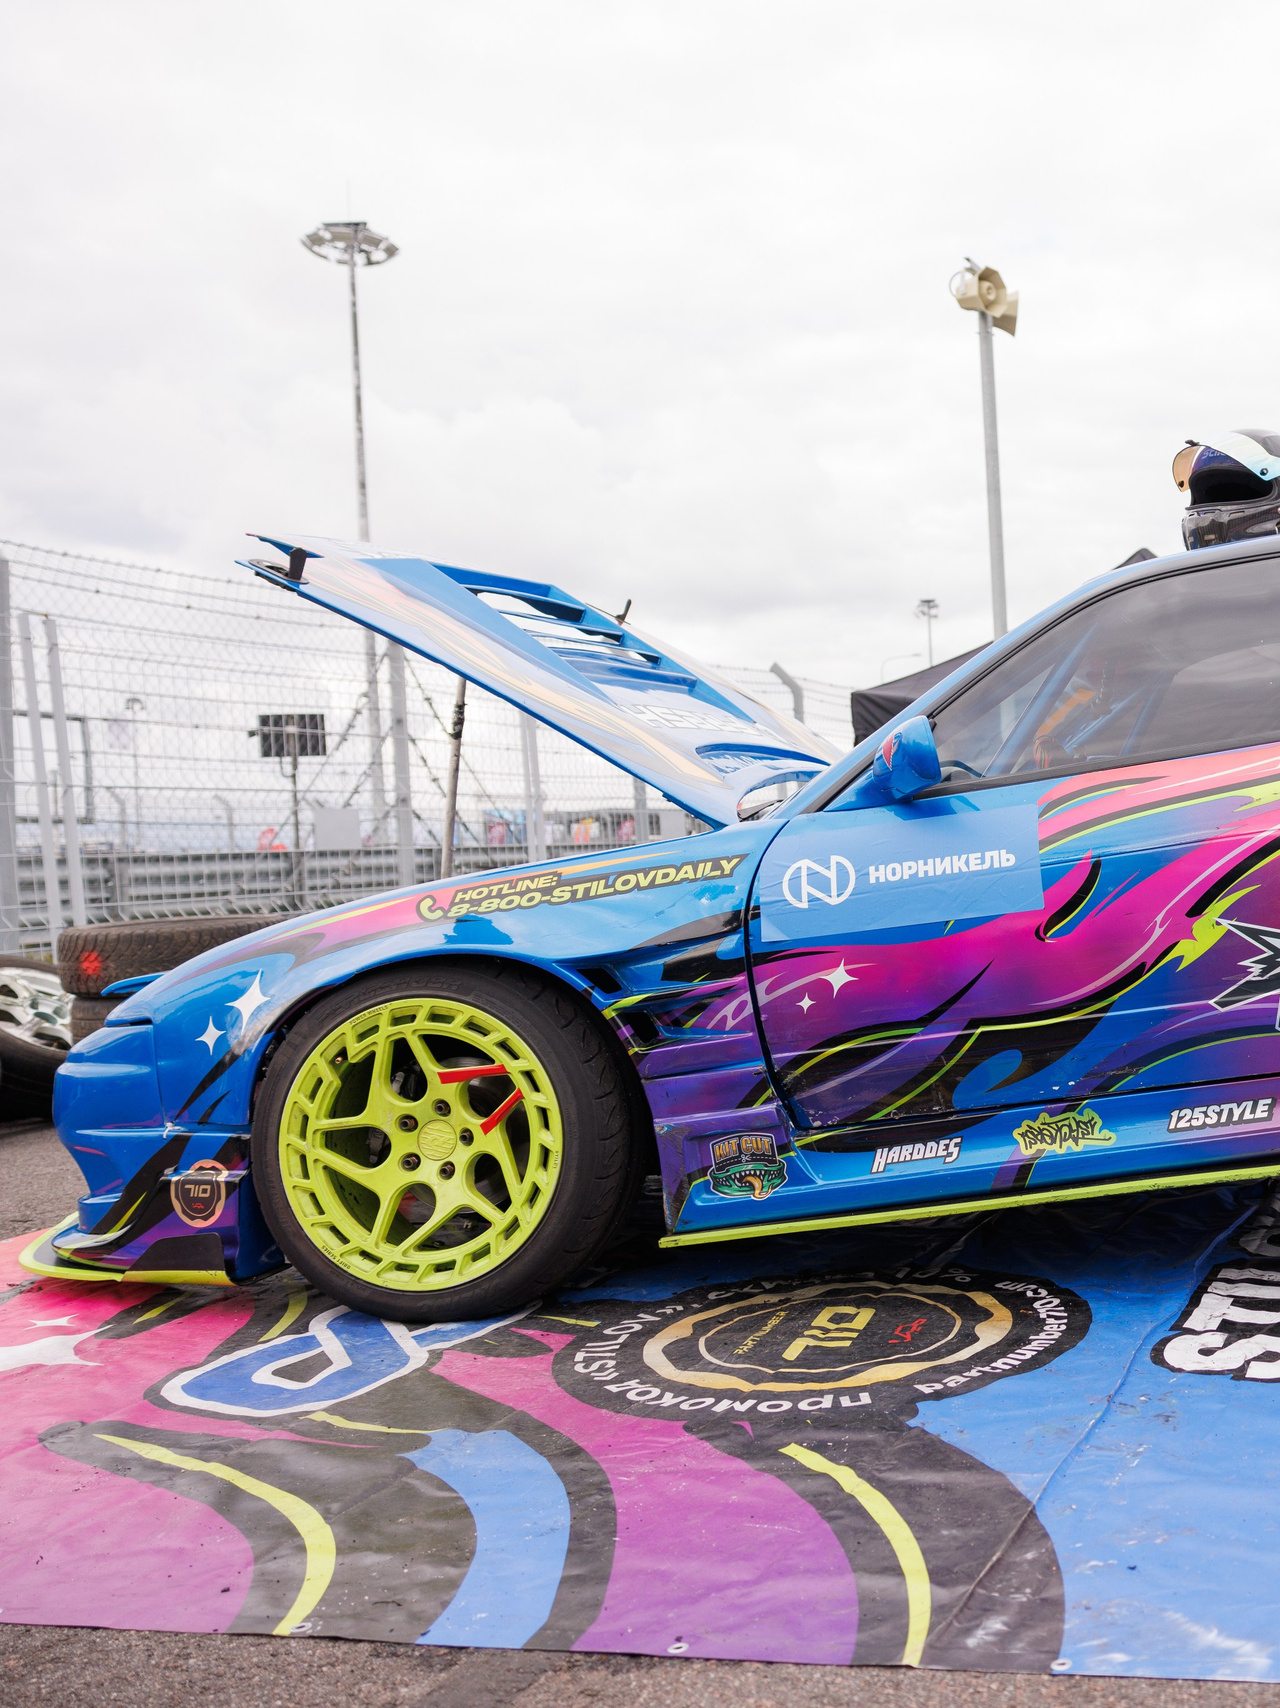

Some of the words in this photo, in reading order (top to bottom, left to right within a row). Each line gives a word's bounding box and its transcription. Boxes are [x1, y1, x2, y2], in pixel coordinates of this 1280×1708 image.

[868, 849, 1017, 884] НОРНИКЕЛЬ
[446, 858, 741, 918] 8-800-STILOVDAILY
[454, 875, 558, 903] HOTLINE:
[1168, 1098, 1273, 1130] 125STYLE
[714, 1137, 740, 1163] KIT
[740, 1135, 772, 1156] CUT
[871, 1137, 962, 1174] HARDDES
